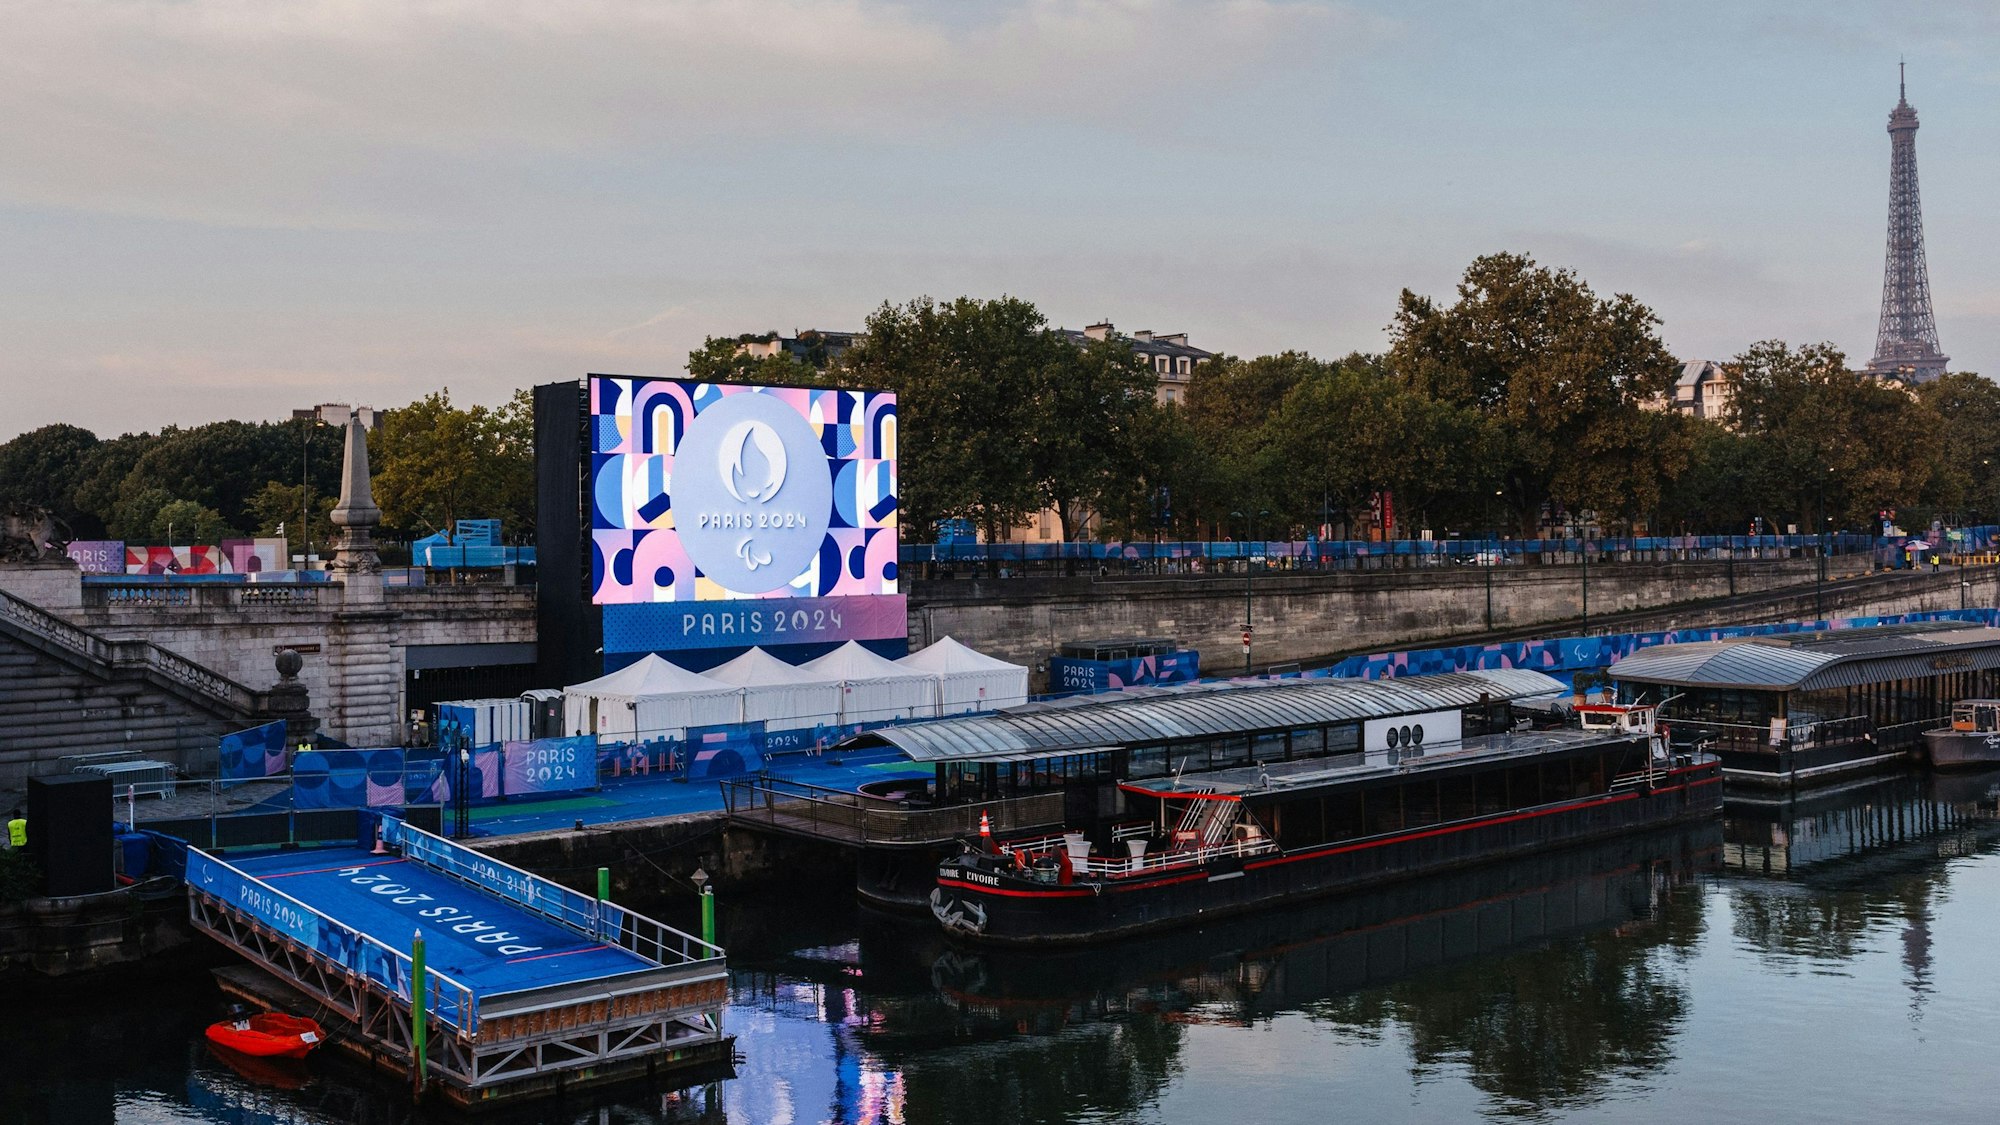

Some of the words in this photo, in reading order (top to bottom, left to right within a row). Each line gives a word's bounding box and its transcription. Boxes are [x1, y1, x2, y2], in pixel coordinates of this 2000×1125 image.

[699, 512, 753, 529] PARIS
[759, 512, 807, 528] 2024
[67, 549, 108, 562] ARIS
[683, 611, 762, 636] PARIS
[774, 609, 842, 632] 2024
[1063, 665, 1095, 678] PARIS
[1063, 676, 1095, 689] 2024
[767, 735, 799, 748] 2024
[526, 747, 576, 765] PARIS
[527, 765, 576, 784] 2024
[338, 866, 435, 905] 2024
[966, 871, 1000, 886] L'IVOIRE
[240, 885, 272, 915] PARIS
[273, 902, 304, 933] 2024
[418, 905, 544, 956] PARIS
